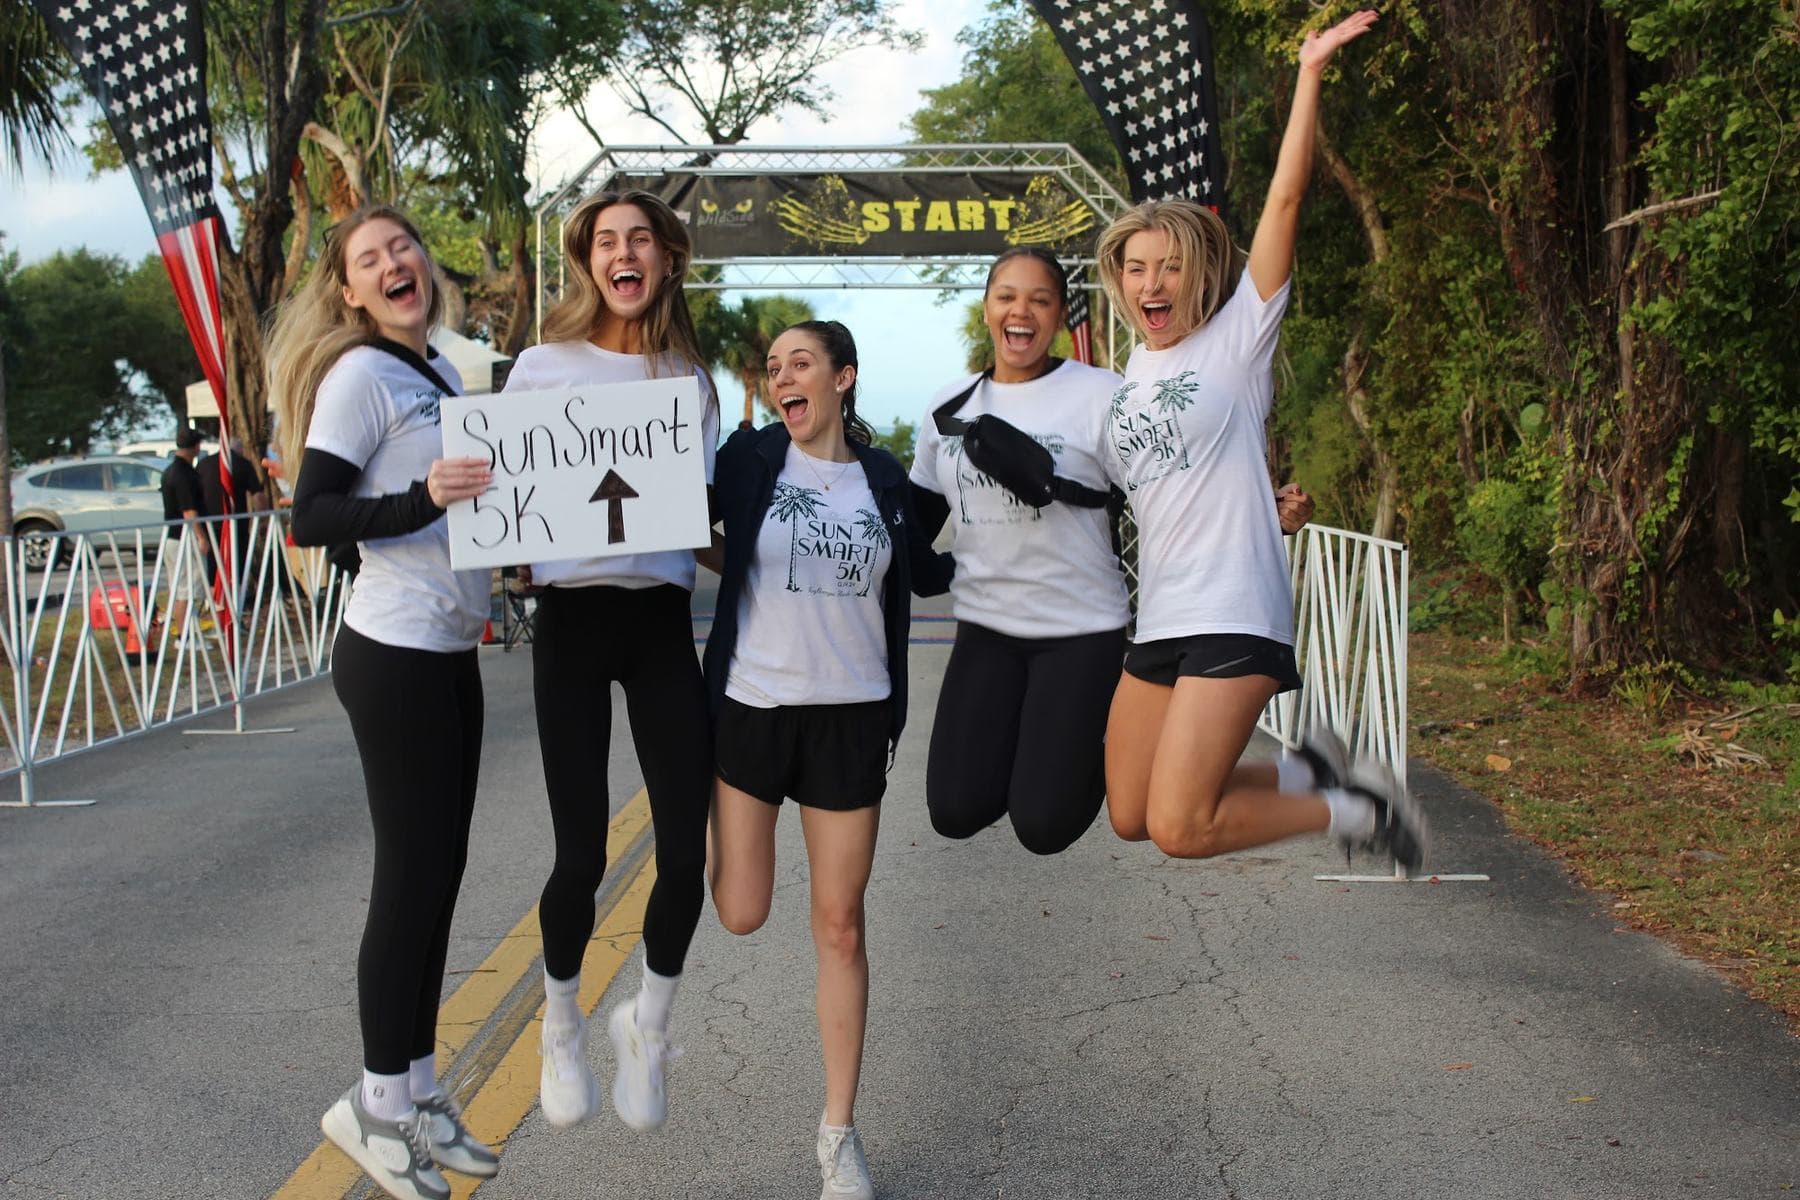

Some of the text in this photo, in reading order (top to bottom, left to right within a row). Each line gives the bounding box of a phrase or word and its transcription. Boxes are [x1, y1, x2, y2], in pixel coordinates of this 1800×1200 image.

[861, 199, 1016, 232] START
[463, 396, 690, 476] SunSmart
[1118, 418, 1174, 458] SMART
[1119, 408, 1152, 438] SUN
[1151, 440, 1176, 462] 5K
[472, 485, 554, 549] 5K
[807, 520, 853, 541] SUN
[797, 538, 873, 564] SMART
[836, 562, 865, 582] 5K
